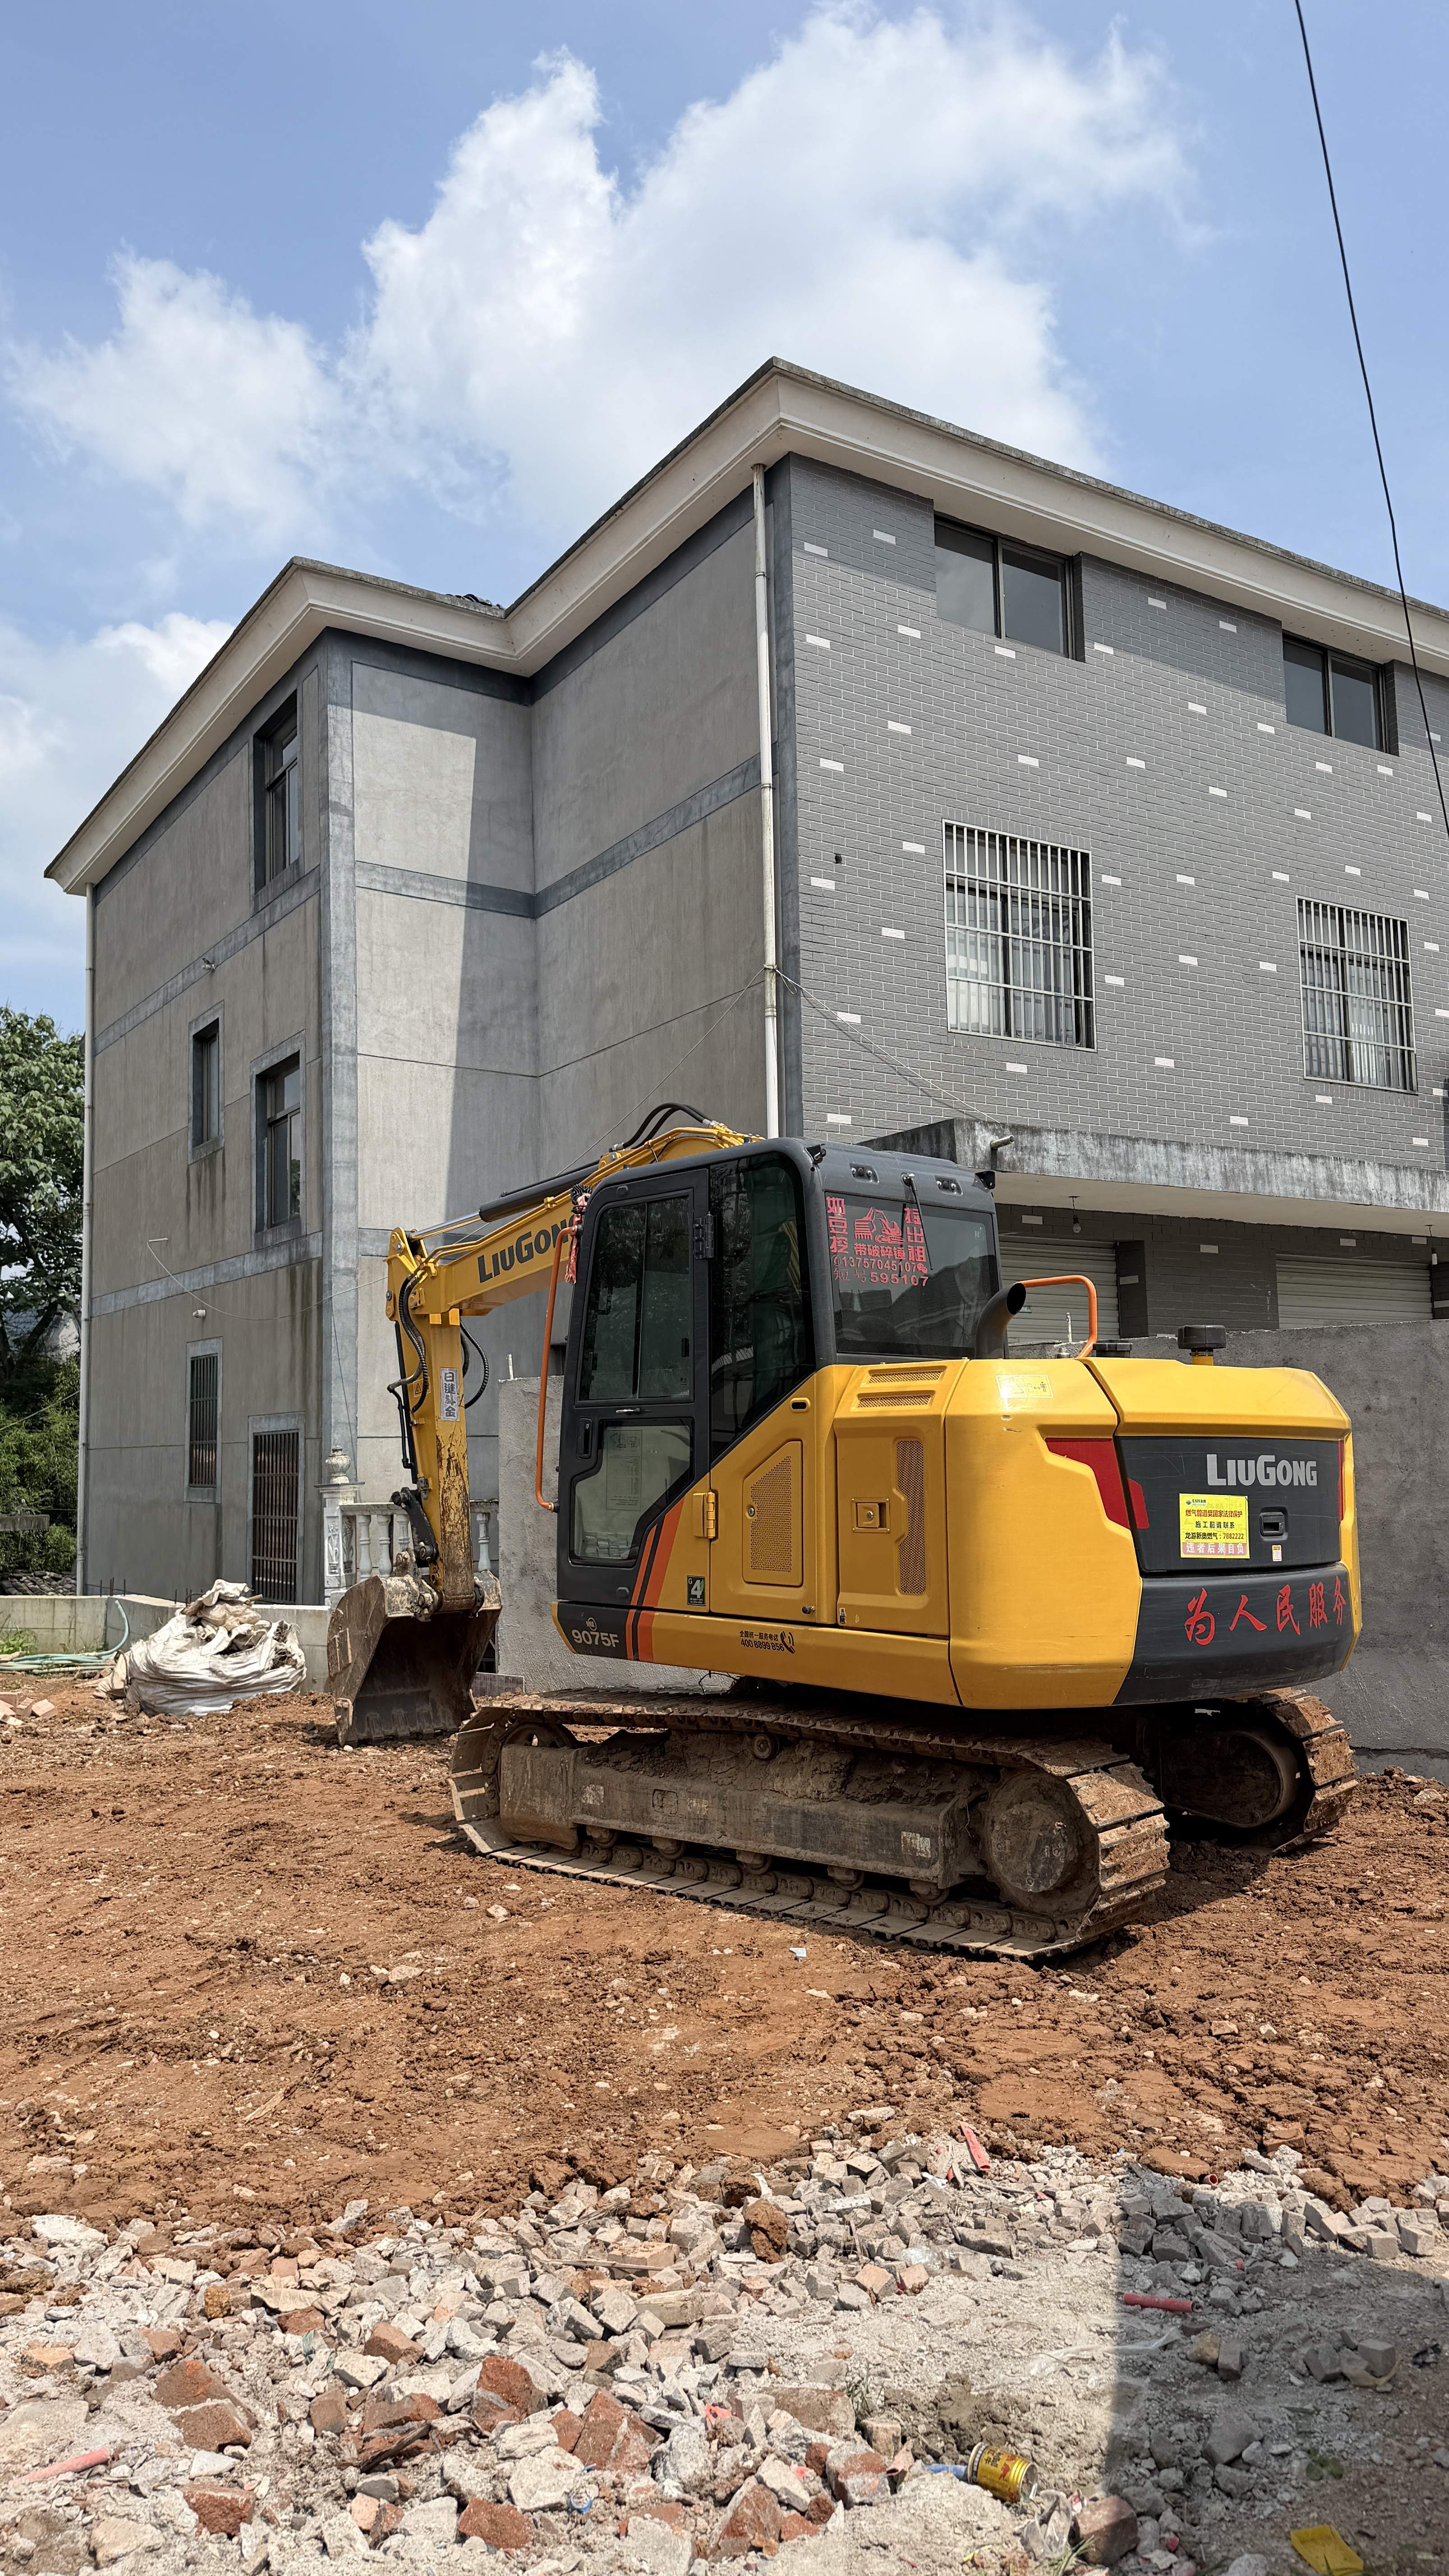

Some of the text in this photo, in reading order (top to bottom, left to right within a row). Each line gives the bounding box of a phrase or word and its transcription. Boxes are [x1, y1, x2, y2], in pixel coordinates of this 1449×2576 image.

[854, 1242, 905, 1260] 带破碎锤
[1184, 1576, 1346, 1646] 为人民服务
[572, 1629, 619, 1647] 9075F
[741, 1639, 784, 1651] 400 8899 856
